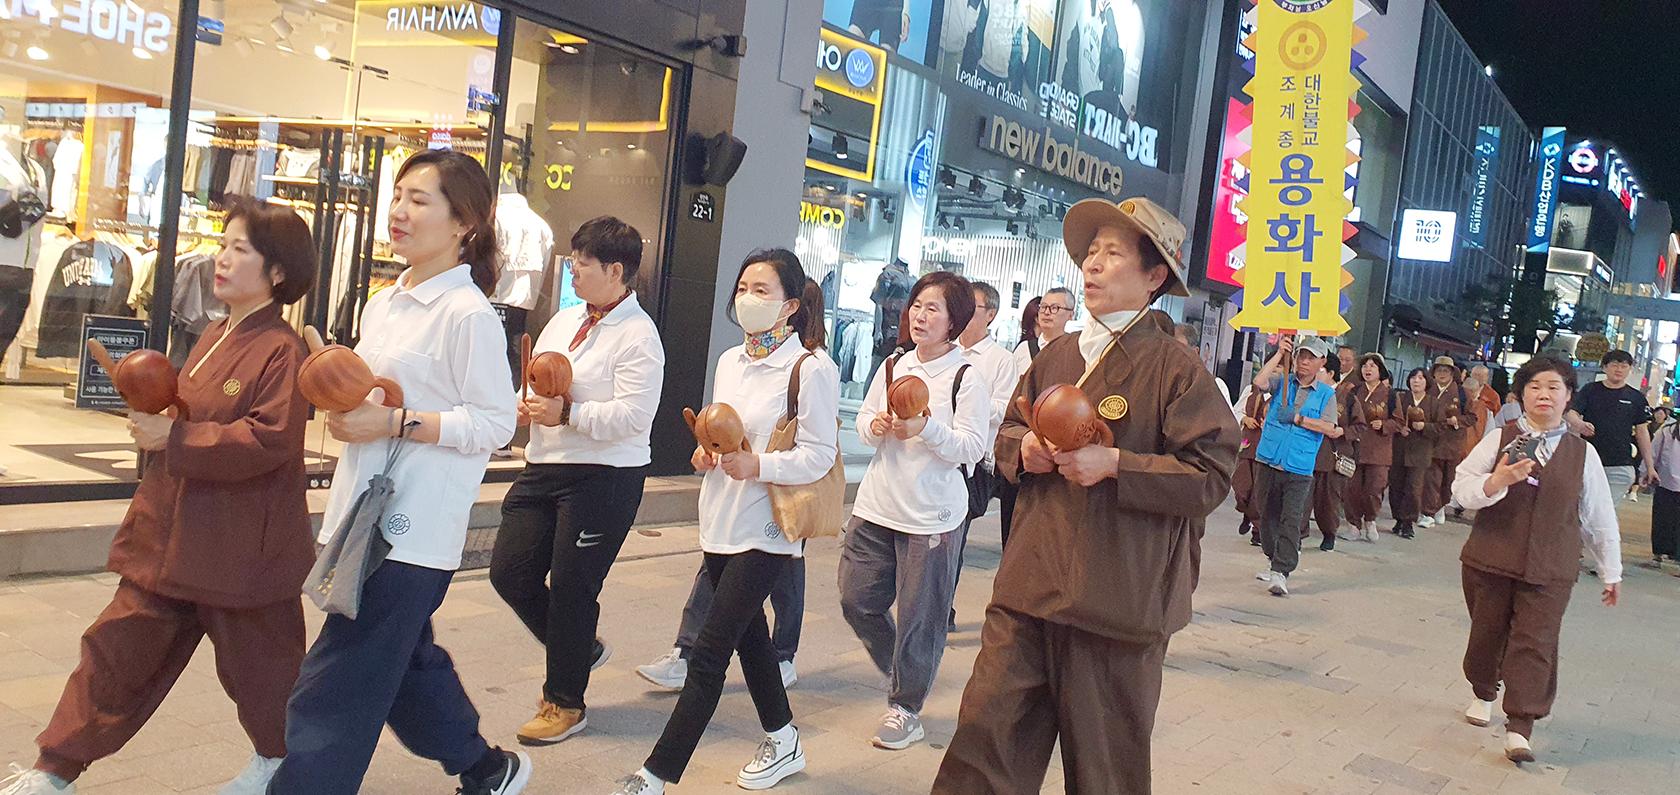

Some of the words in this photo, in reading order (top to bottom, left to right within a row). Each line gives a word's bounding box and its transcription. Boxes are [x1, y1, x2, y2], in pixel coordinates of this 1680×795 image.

[955, 63, 986, 95] Leader
[987, 81, 996, 101] in
[996, 81, 1028, 111] Classics
[1278, 75, 1296, 149] 조계종
[1301, 74, 1321, 146] 대한불교
[990, 115, 1041, 163] new
[1041, 128, 1123, 196] balance
[692, 203, 713, 221] 22-1
[1261, 153, 1324, 320] 용화사
